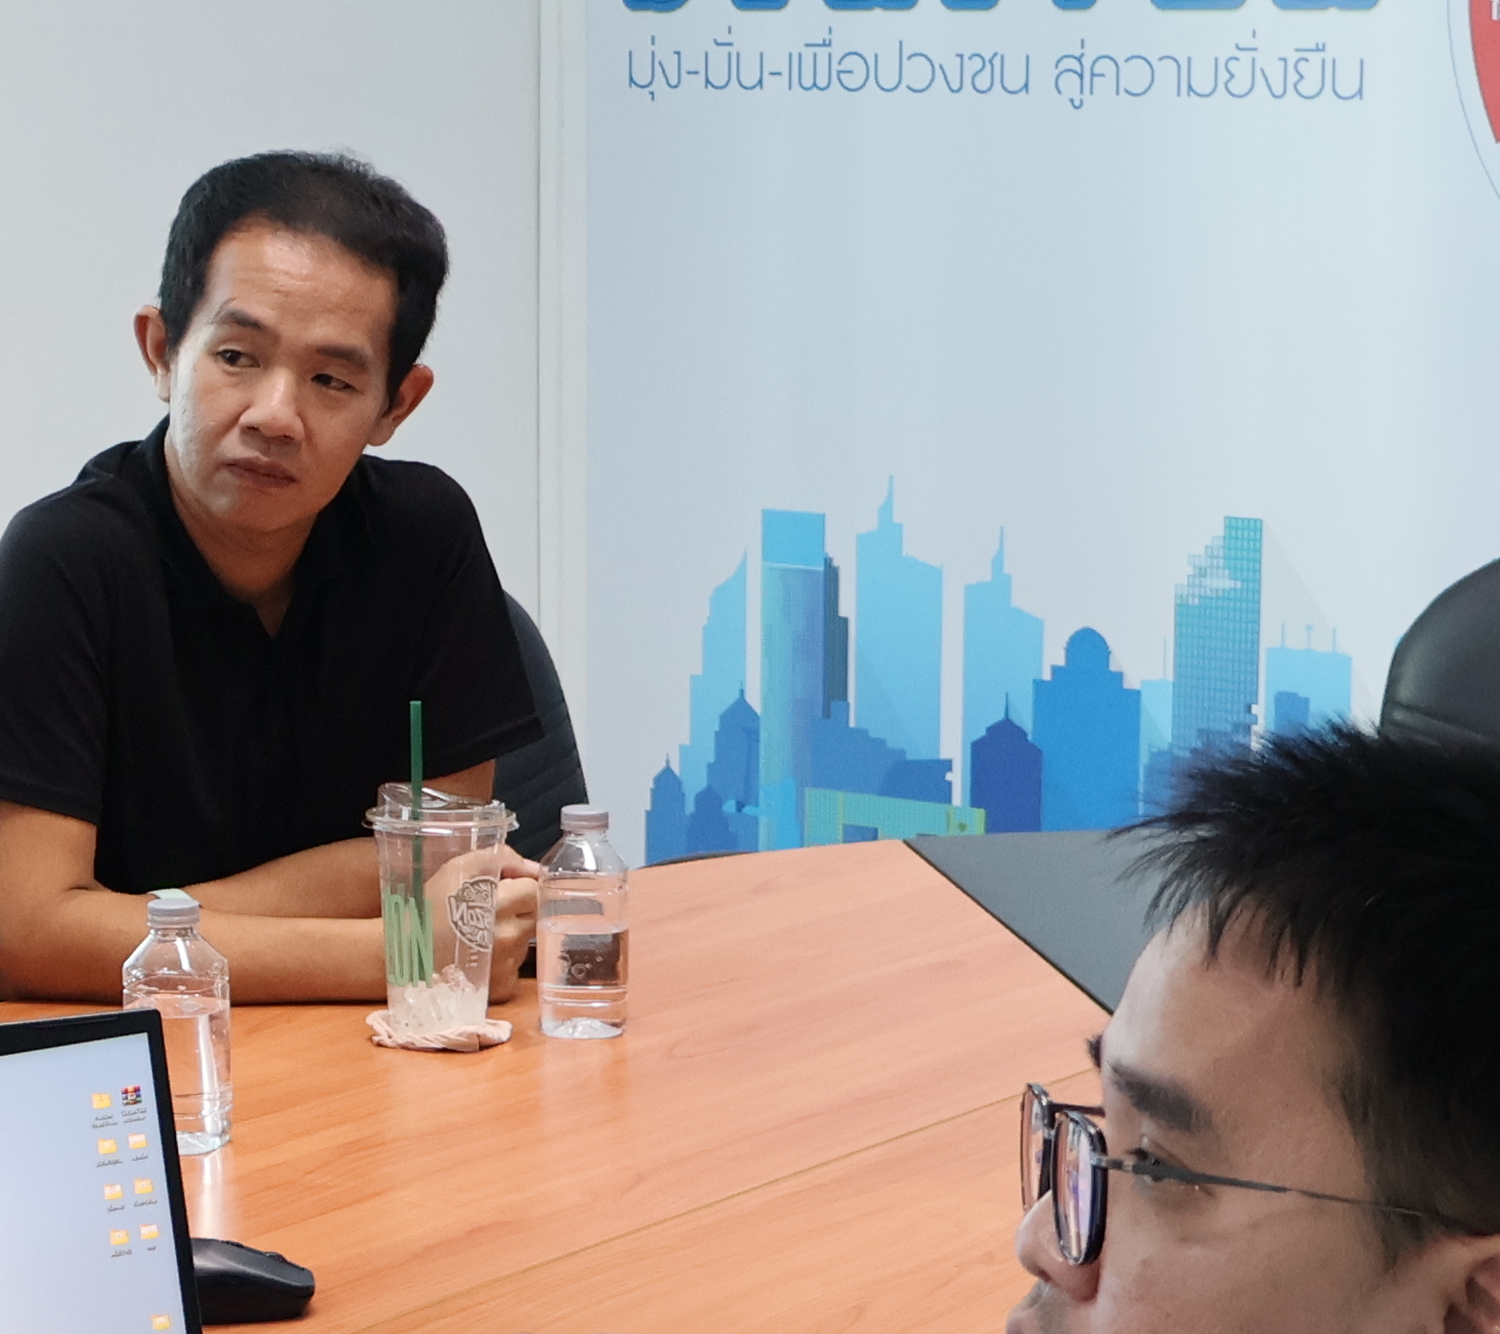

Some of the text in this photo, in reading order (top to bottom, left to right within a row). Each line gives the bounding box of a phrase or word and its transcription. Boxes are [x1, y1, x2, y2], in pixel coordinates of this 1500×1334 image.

[1054, 29, 1363, 109] สู่ความยั่งยืน
